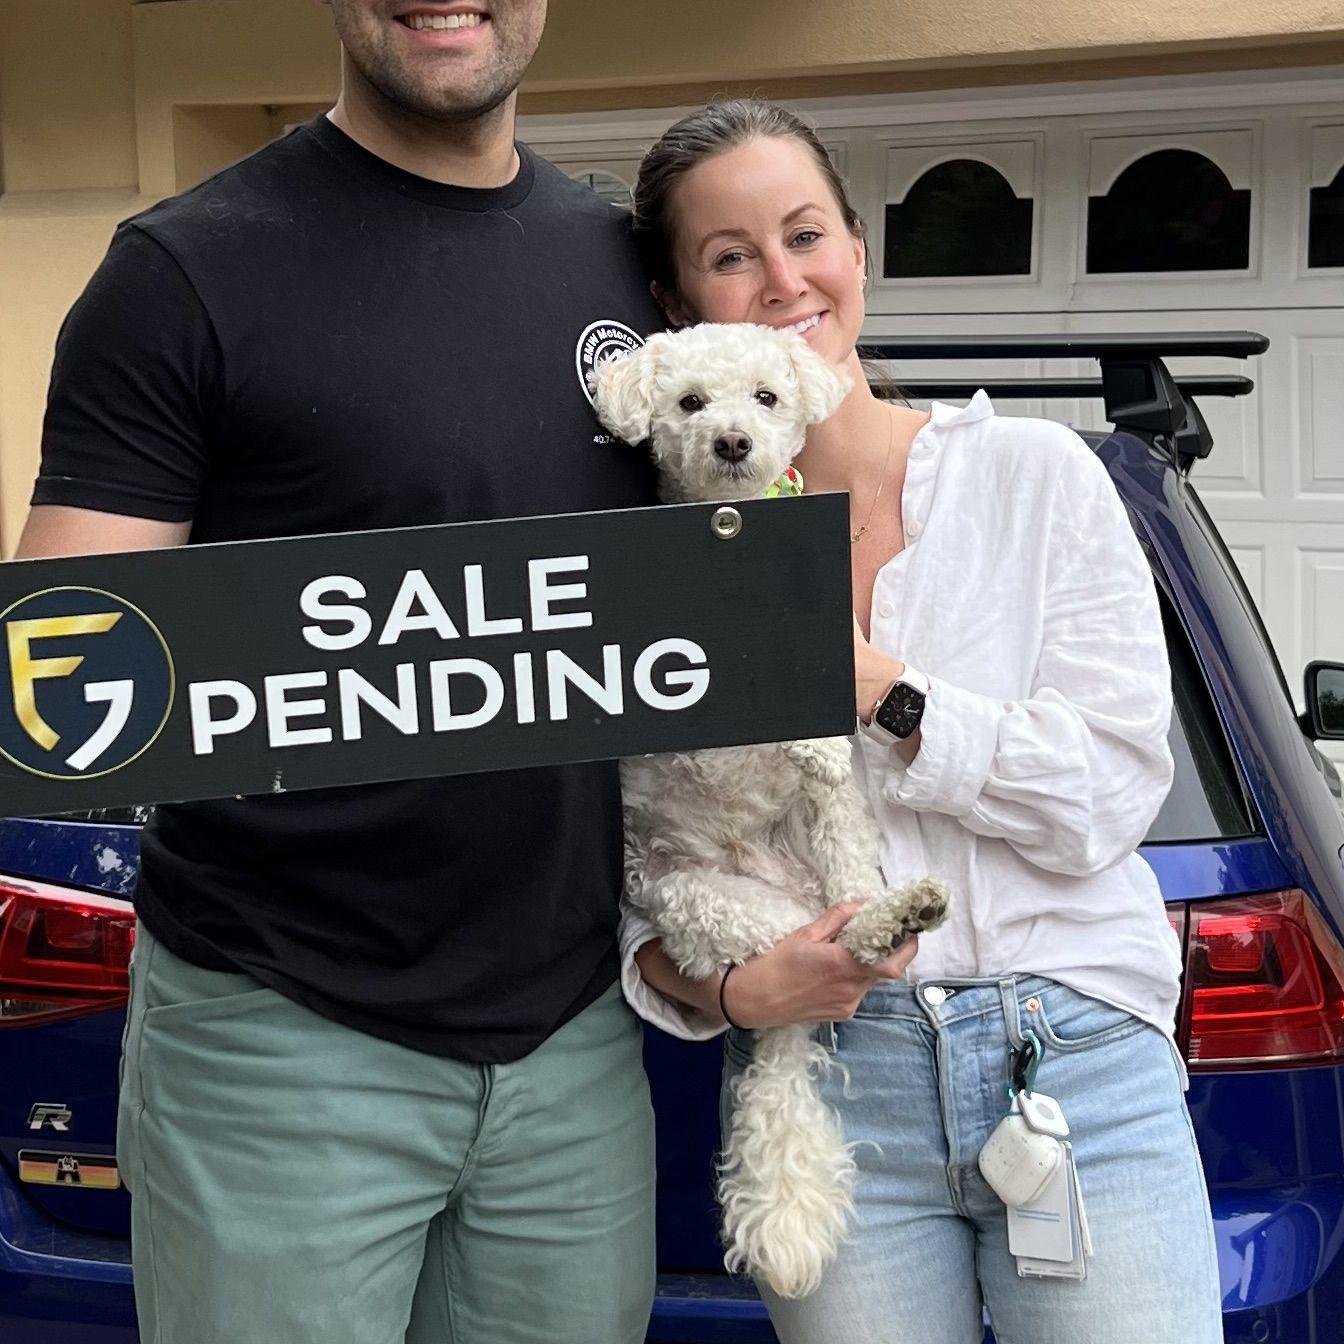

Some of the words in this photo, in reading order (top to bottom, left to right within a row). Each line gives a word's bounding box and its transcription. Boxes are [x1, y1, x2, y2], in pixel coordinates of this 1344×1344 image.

[583, 333, 599, 364] BMW
[299, 555, 593, 651] SALE
[188, 638, 711, 755] PENDING
[27, 1102, 72, 1131] R
